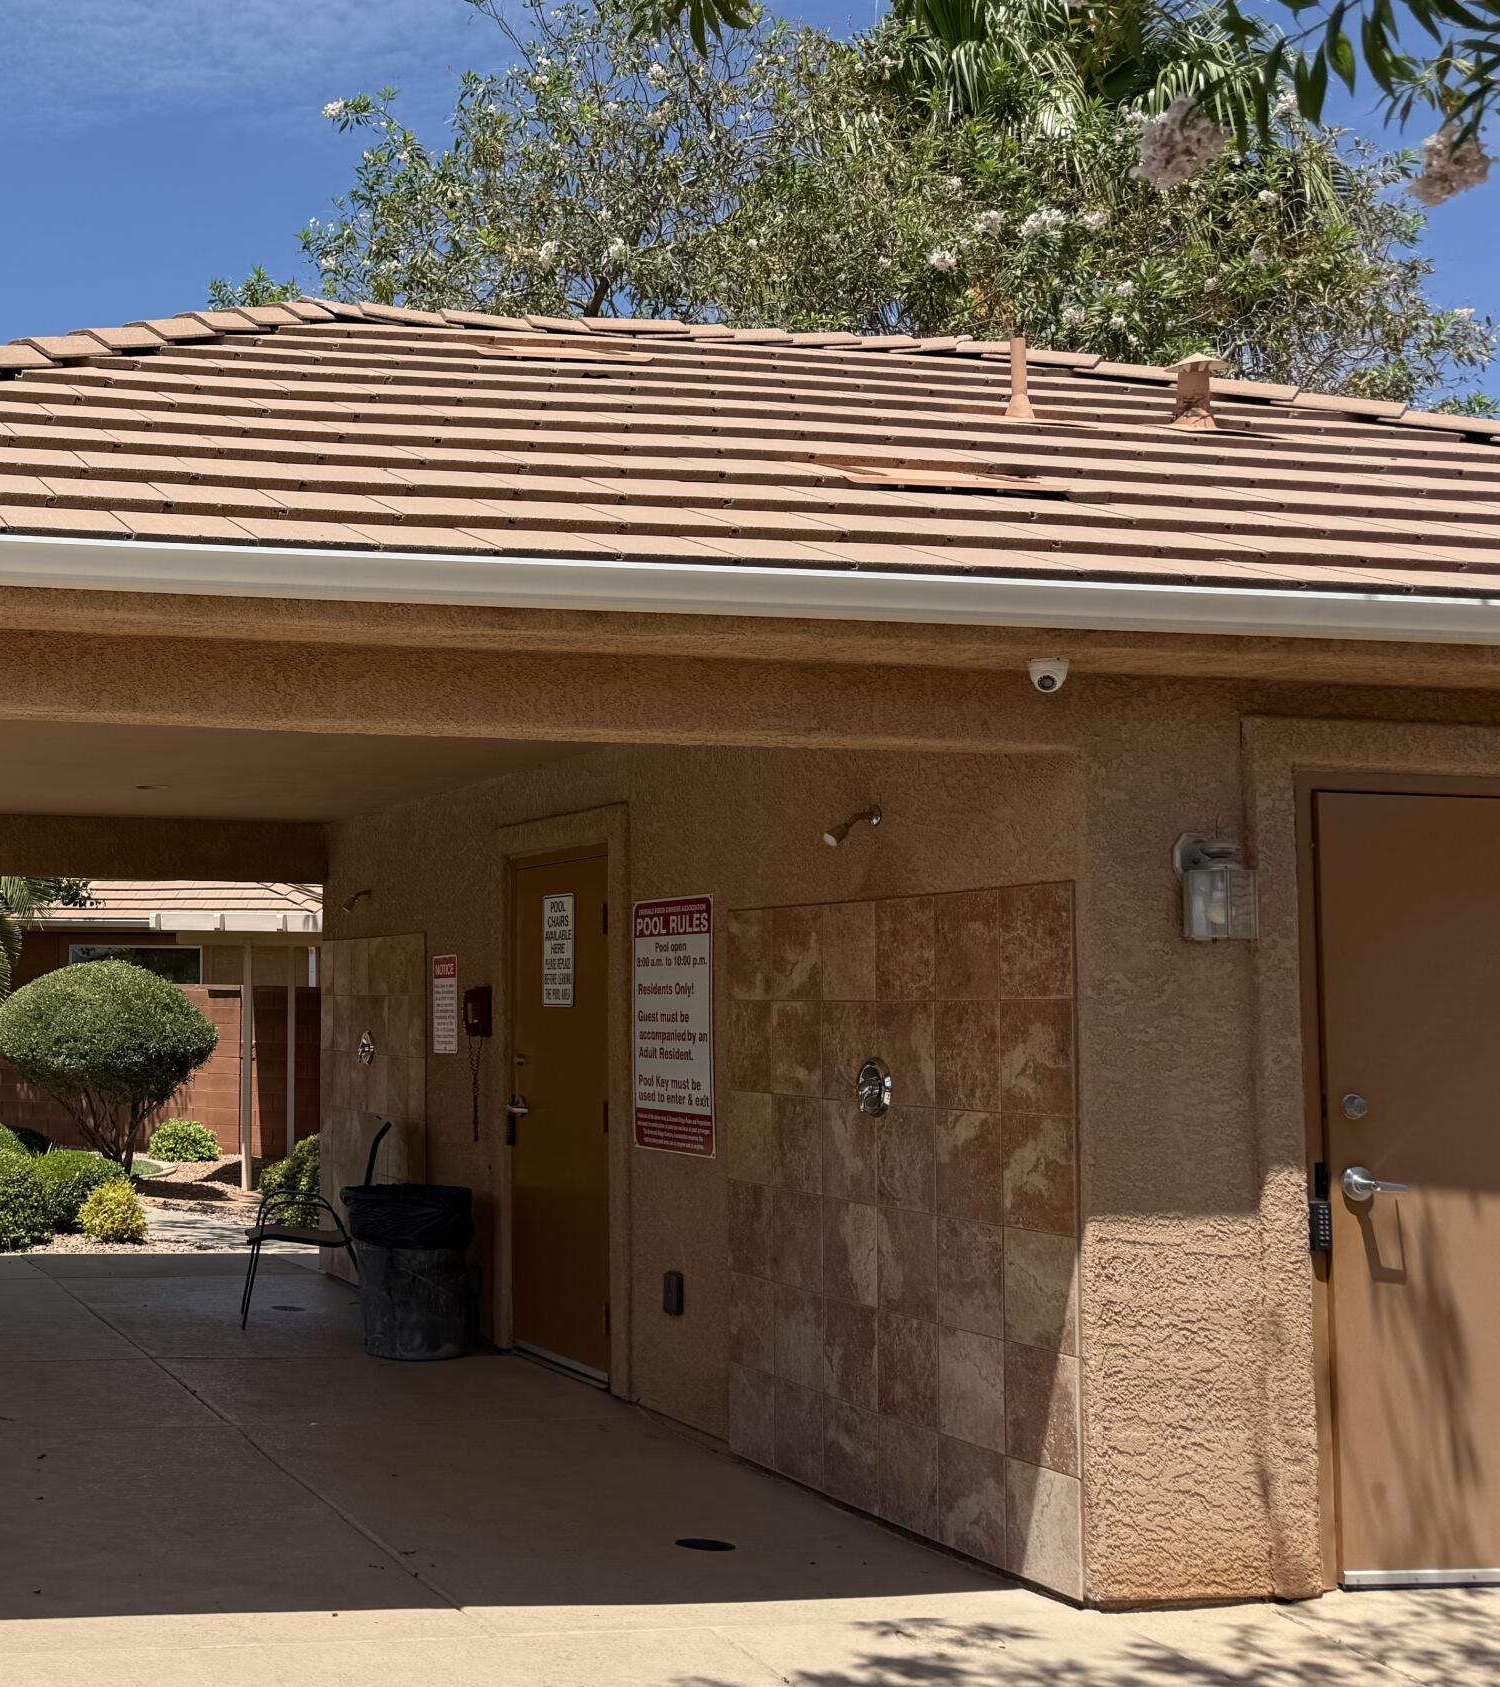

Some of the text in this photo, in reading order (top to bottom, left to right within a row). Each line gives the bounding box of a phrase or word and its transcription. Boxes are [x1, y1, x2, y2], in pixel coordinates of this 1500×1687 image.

[550, 900, 566, 913] POOL
[547, 915, 569, 928] CHAIRS
[636, 912, 709, 936] POOL RULES
[545, 929, 572, 941] AVAILABLE
[550, 943, 565, 954] HERE
[655, 942, 687, 954] Pool open
[665, 957, 672, 967] to
[674, 956, 691, 966] 10:00
[692, 956, 708, 968] p.m.
[435, 963, 455, 976] NOTICE
[638, 982, 694, 998] Residents Only!
[638, 1010, 690, 1023] Guest must be
[639, 1029, 708, 1044] accompanied by an
[638, 1047, 694, 1061] Adult Resident.
[638, 1074, 701, 1091] Pool Key must be
[638, 1090, 709, 1108] used to enter & exit
